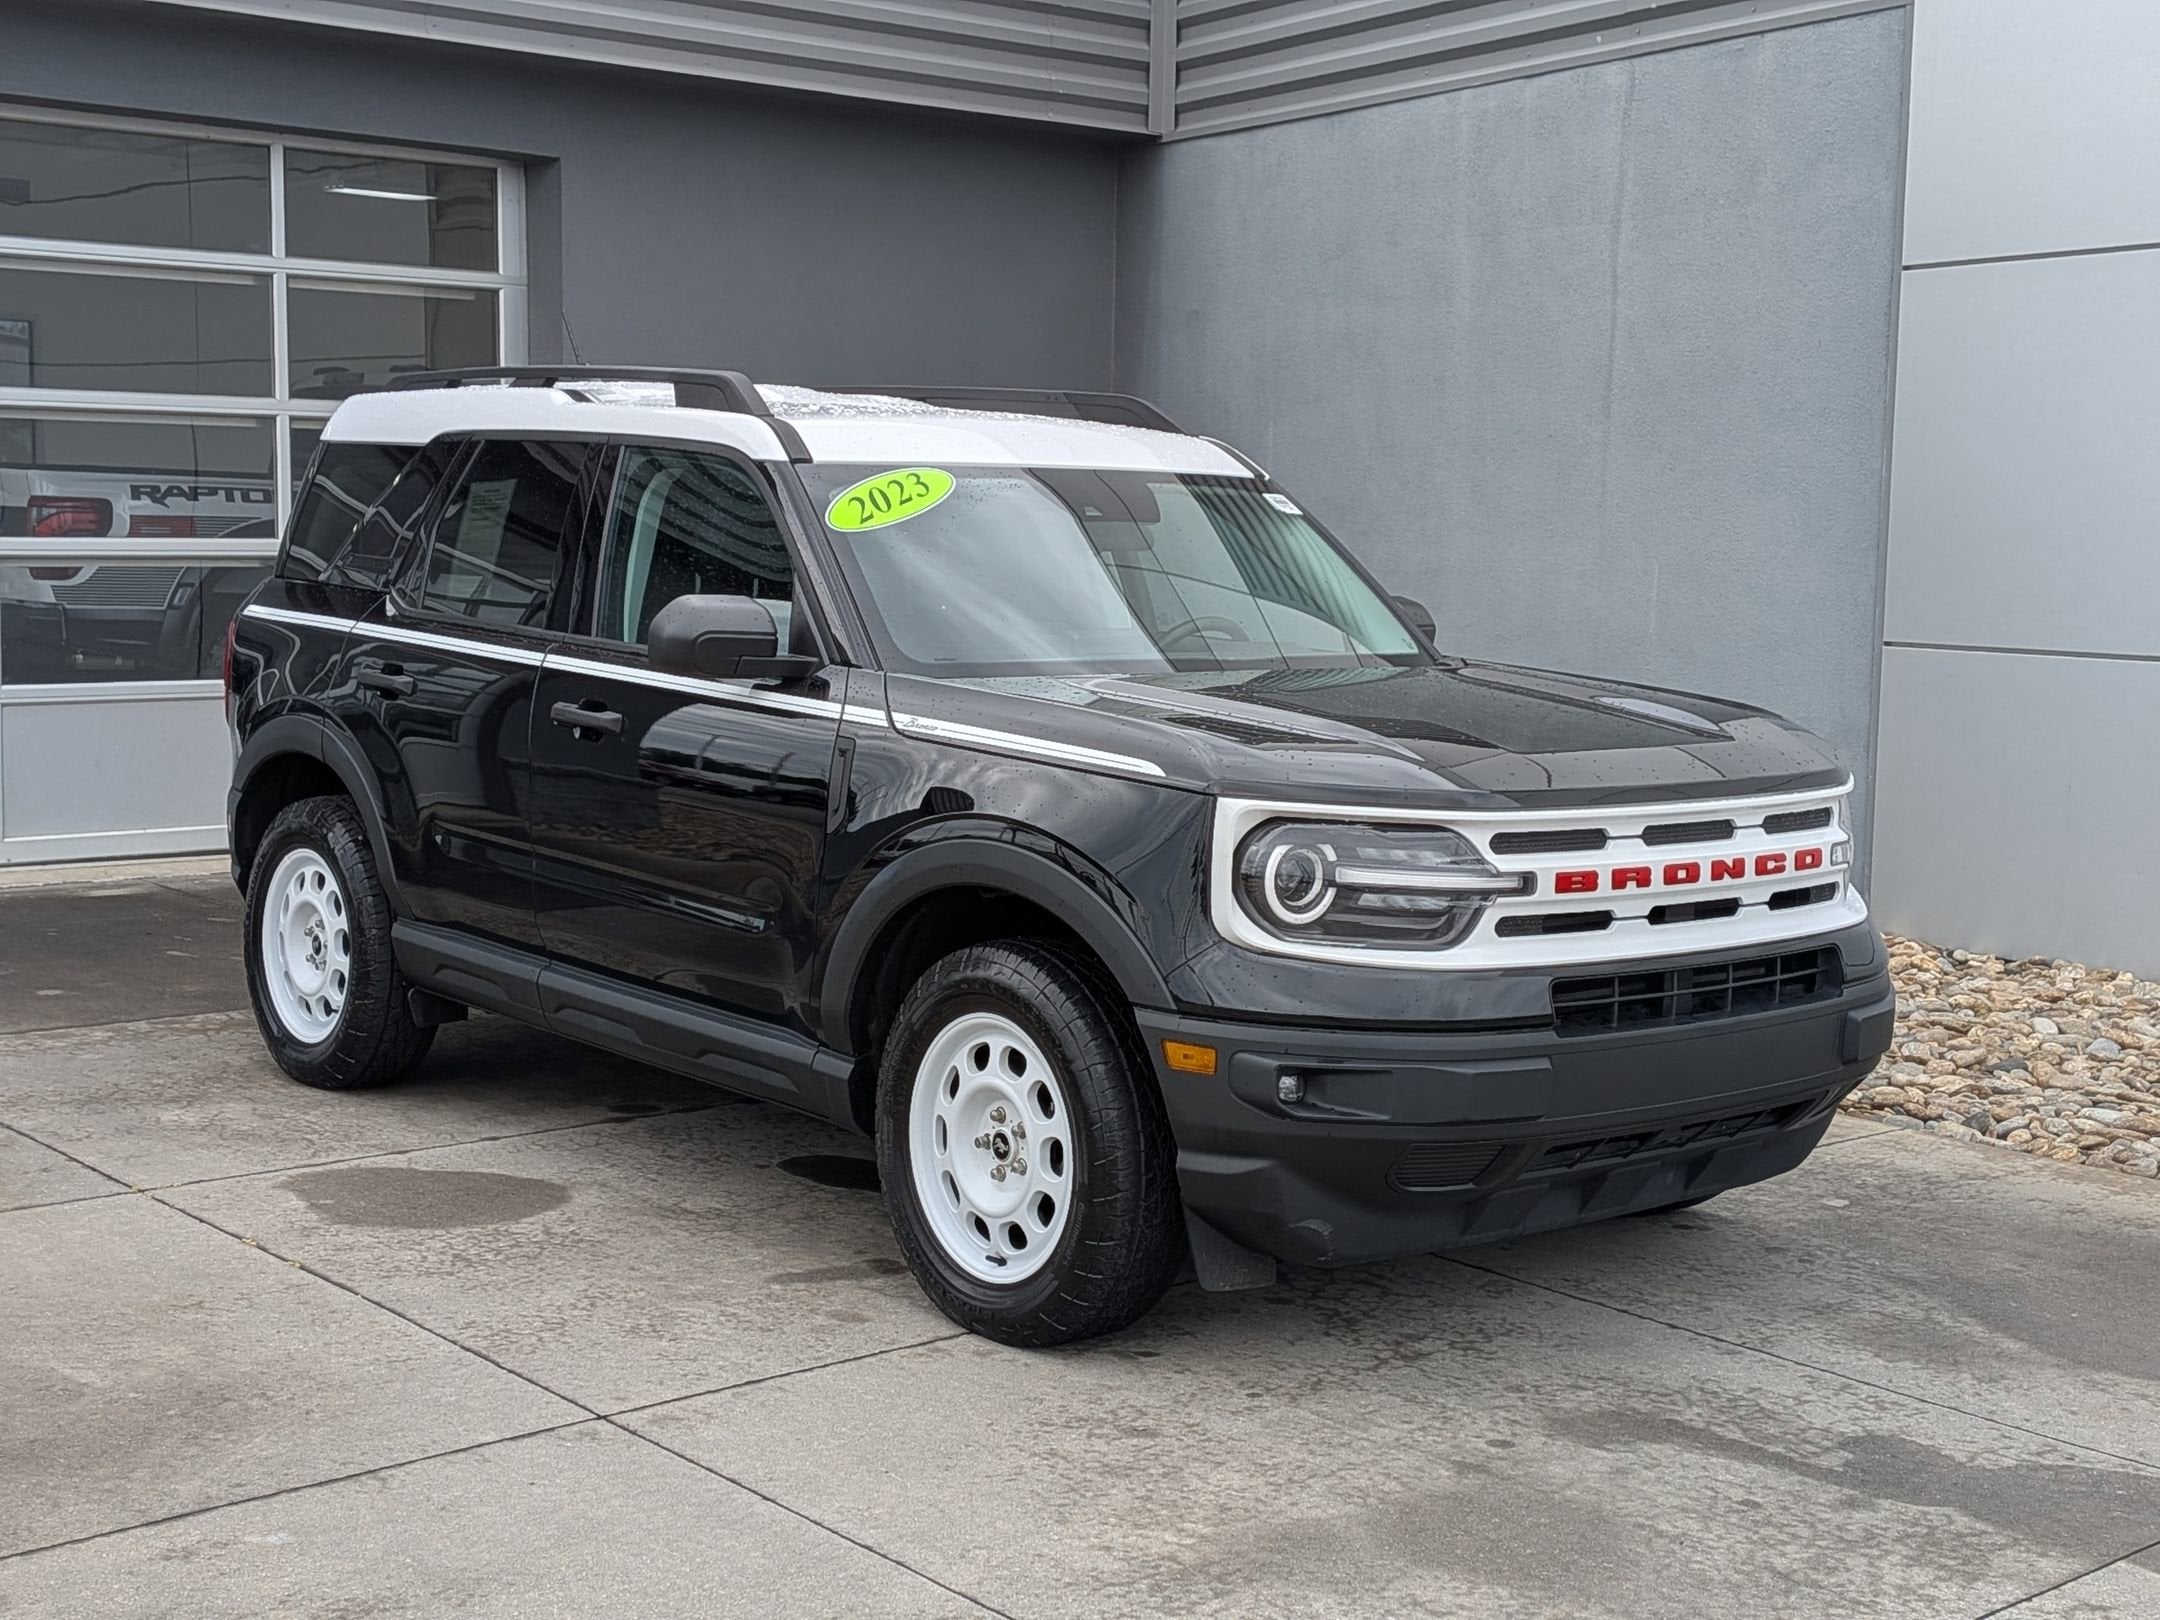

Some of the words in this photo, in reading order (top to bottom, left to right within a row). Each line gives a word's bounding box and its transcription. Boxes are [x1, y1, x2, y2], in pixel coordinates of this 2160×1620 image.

[129, 484, 273, 508] RAPTO
[848, 473, 930, 524] 2023
[1555, 847, 1823, 894] BRONCO
